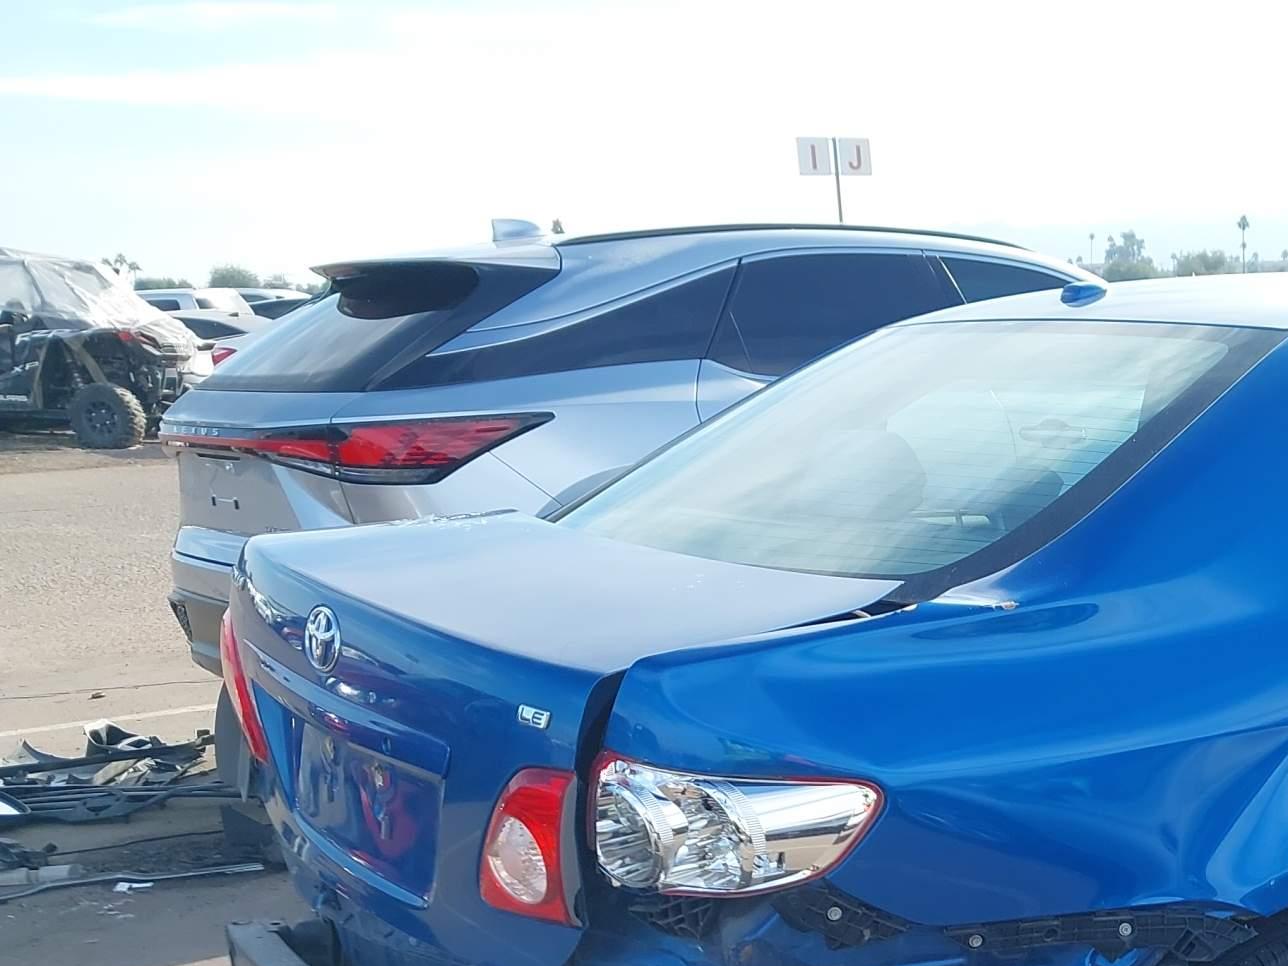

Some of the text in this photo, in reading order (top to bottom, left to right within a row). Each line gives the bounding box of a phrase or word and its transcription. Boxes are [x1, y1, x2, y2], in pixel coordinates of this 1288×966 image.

[811, 144, 862, 170] I J
[520, 706, 545, 727] LE
